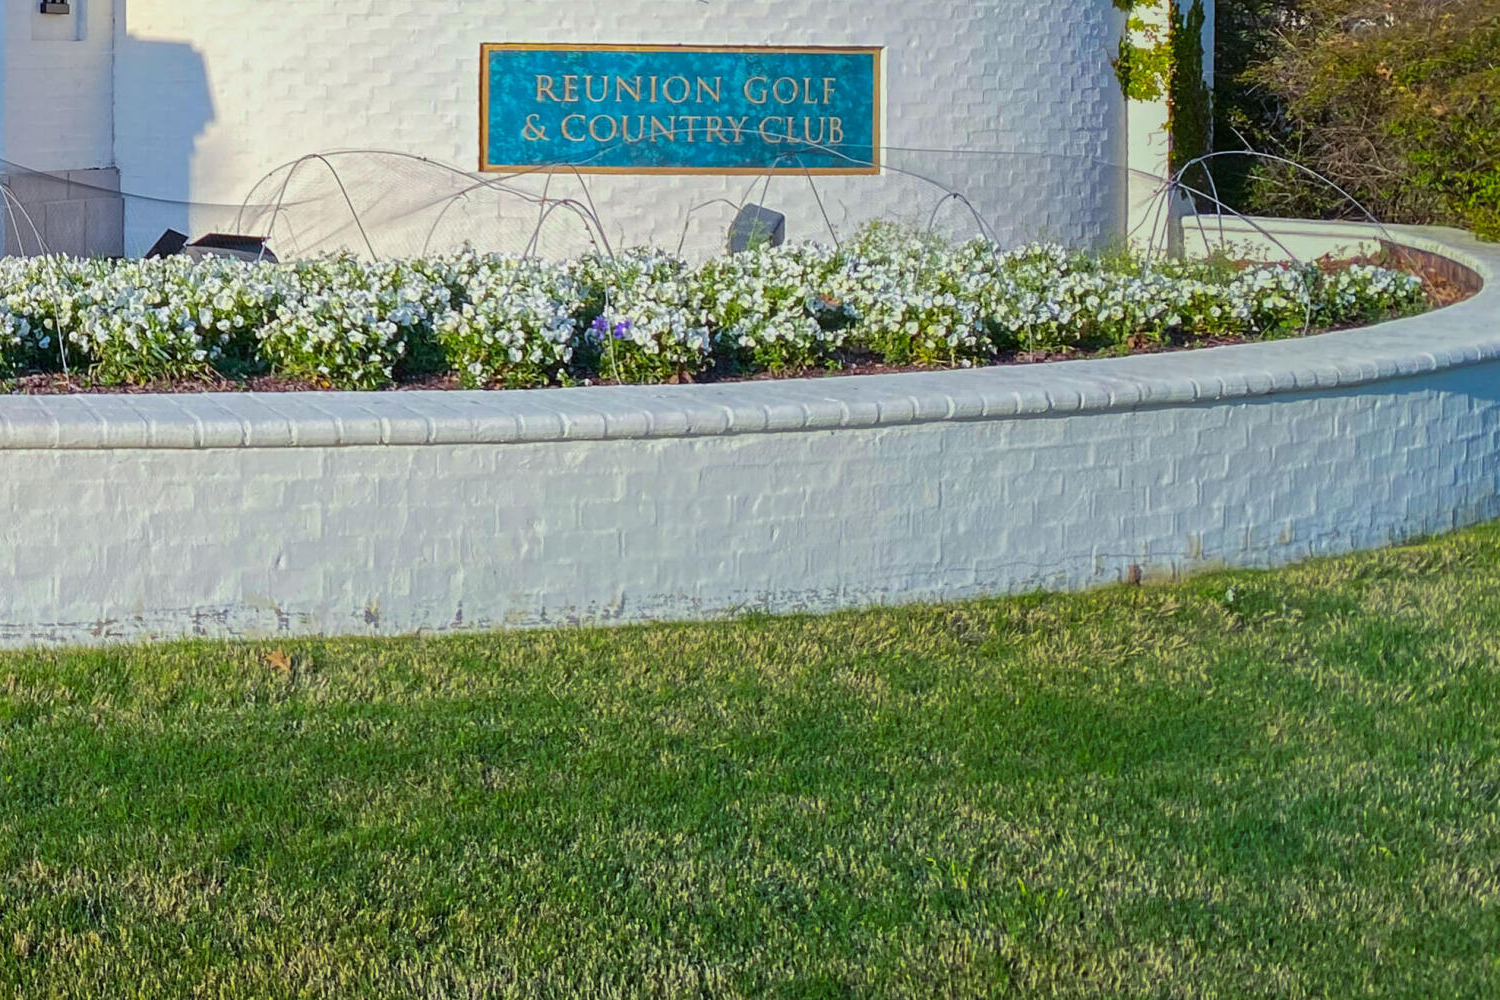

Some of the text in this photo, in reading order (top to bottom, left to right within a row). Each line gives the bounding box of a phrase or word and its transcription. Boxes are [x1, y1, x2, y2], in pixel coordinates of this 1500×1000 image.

[534, 75, 837, 105] REUNION GOLF
[521, 113, 845, 145] & COUNTRY CLUB
